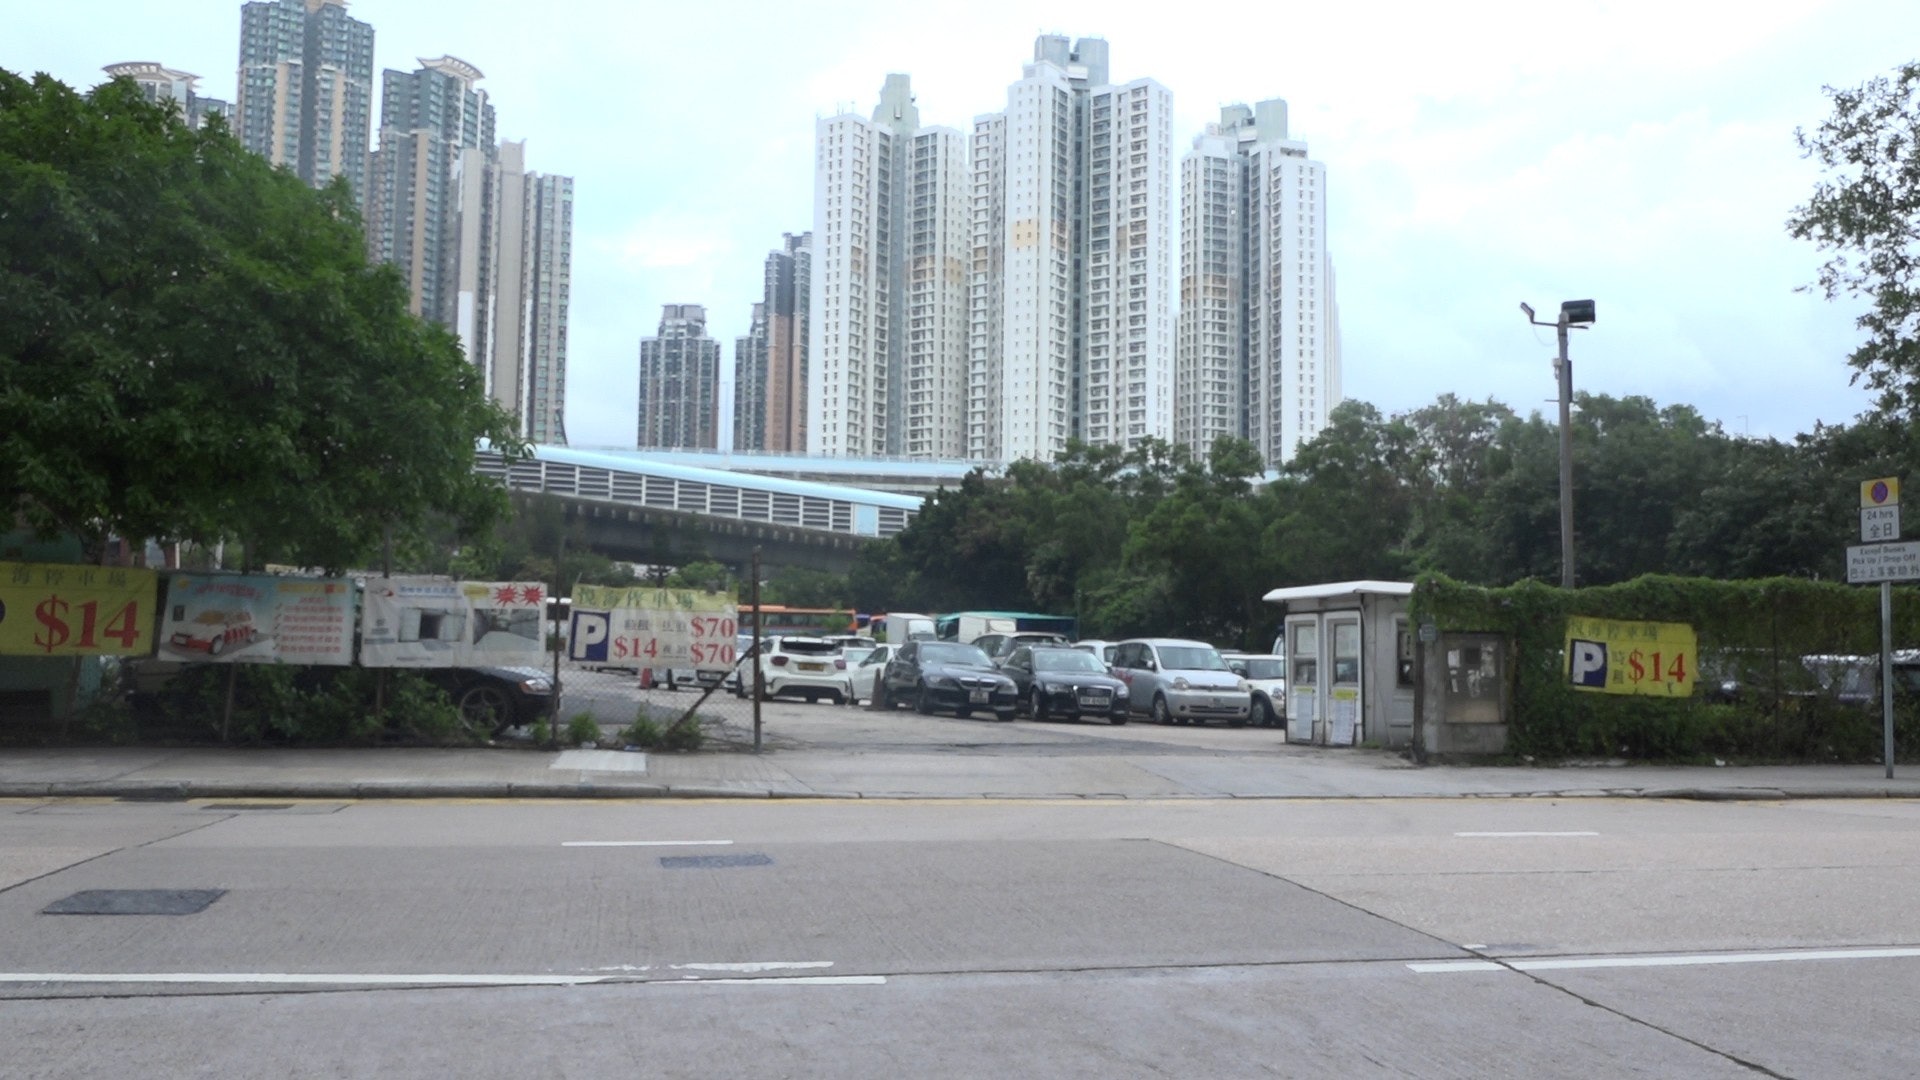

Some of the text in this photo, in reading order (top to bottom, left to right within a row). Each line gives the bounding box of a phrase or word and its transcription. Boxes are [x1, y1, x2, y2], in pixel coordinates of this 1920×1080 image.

[1866, 510, 1894, 520] 24 hrs
[1870, 523, 1893, 539] 全日
[33, 593, 140, 653] $14
[690, 614, 735, 638] $70
[573, 612, 608, 660] P
[613, 635, 657, 660] $14
[690, 641, 735, 666] $70
[1572, 641, 1604, 684] P
[1628, 648, 1686, 684] $14
